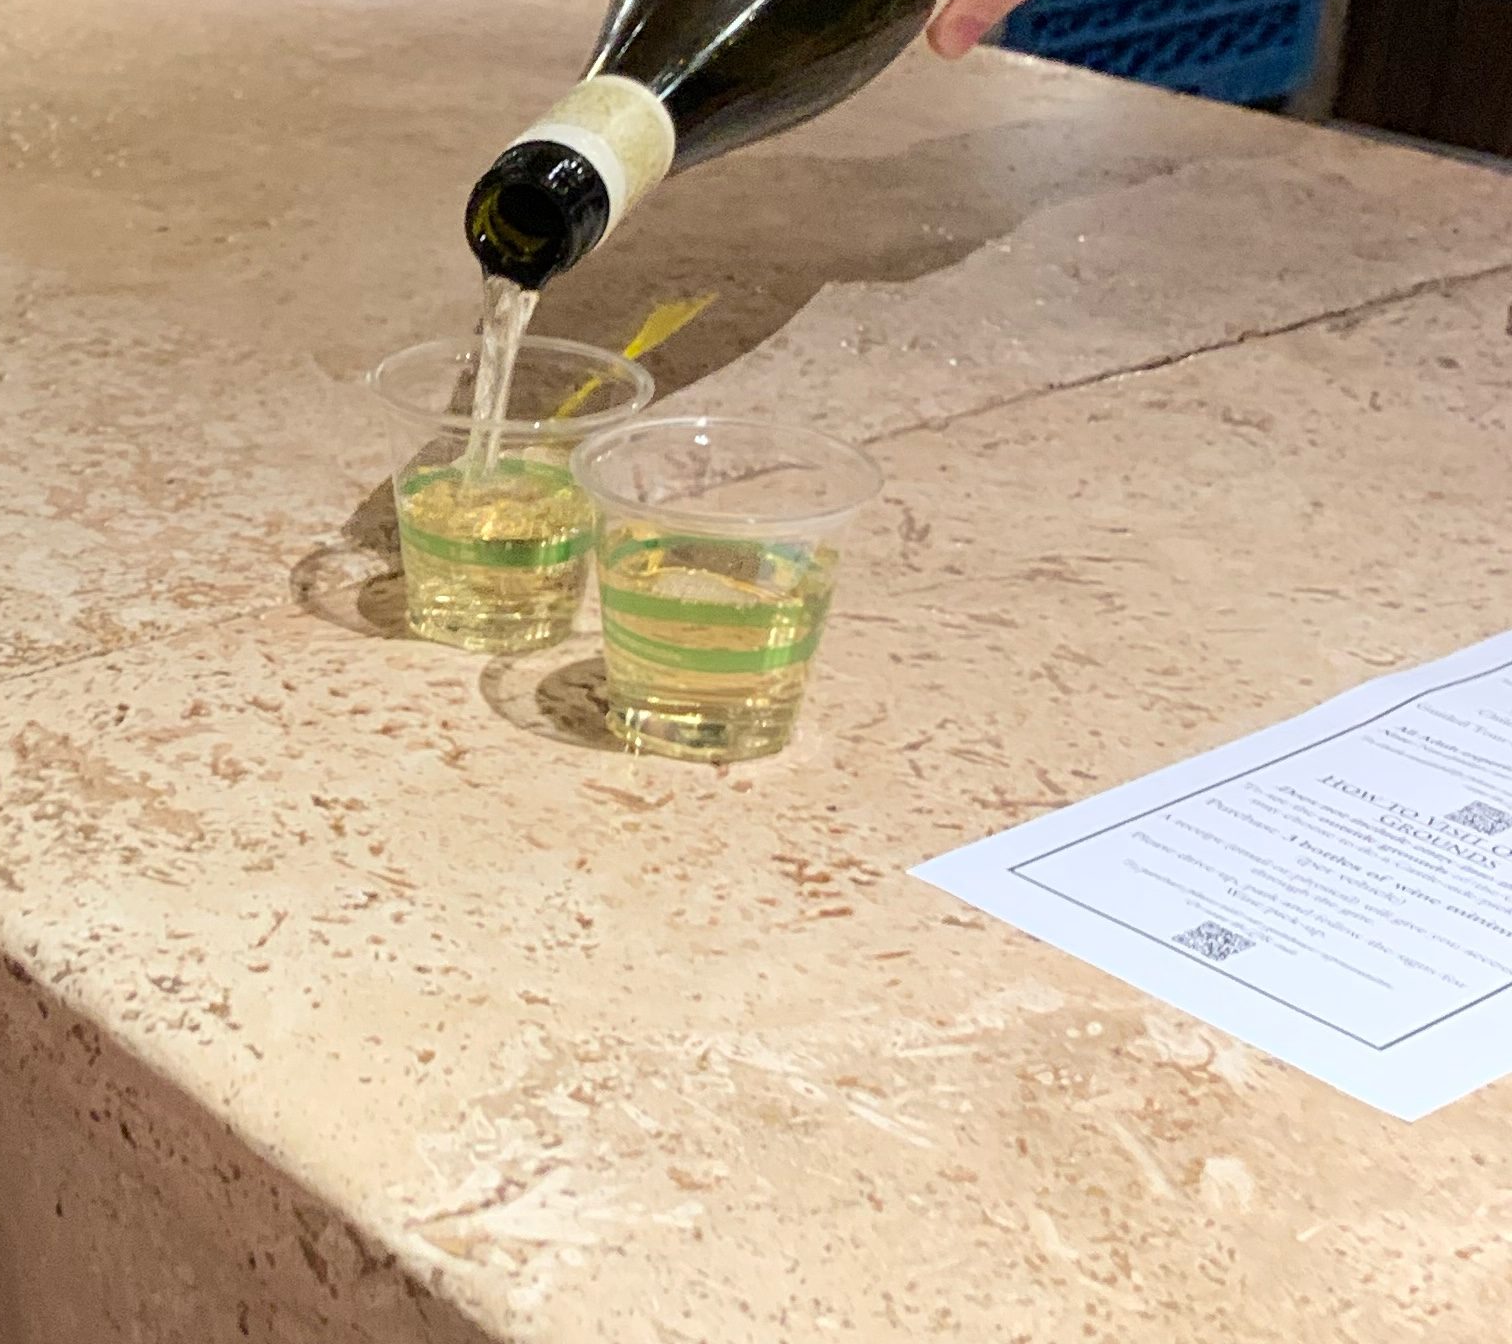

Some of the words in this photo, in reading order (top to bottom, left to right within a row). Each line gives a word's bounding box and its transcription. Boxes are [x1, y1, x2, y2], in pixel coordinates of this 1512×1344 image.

[1415, 701, 1472, 728] Guided
[1289, 803, 1317, 817] the
[1317, 815, 1377, 843] outside
[1377, 843, 1449, 875] grounds
[1316, 774, 1376, 805] HOW
[1379, 802, 1419, 820] TO
[1415, 815, 1488, 848] VISIT
[1318, 803, 1350, 818] not
[1204, 796, 1280, 835] Purchase
[1297, 839, 1362, 872] bottles
[1365, 870, 1394, 882] of
[1394, 881, 1441, 905] wine
[1375, 813, 1496, 869] GROUNDS
[1130, 830, 1177, 854] Please
[1175, 852, 1218, 872] drive
[1215, 871, 1239, 887] up,
[1238, 883, 1282, 903] park
[1279, 900, 1315, 916] and
[1310, 913, 1363, 940] follow
[1364, 939, 1393, 954] the
[1396, 953, 1436, 975] signs
[1438, 972, 1467, 989] for
[1172, 818, 1225, 845] receipt
[1223, 842, 1274, 866] (email
[1287, 872, 1361, 905] physical)
[1363, 903, 1394, 919] will
[1389, 917, 1427, 934] give
[1425, 933, 1461, 950] you
[1226, 886, 1264, 907] Wine
[1248, 866, 1310, 897] through
[1310, 894, 1338, 908] the
[1336, 907, 1374, 924] gate.
[1295, 855, 1335, 875] (per
[1337, 872, 1407, 906] vehicle)
